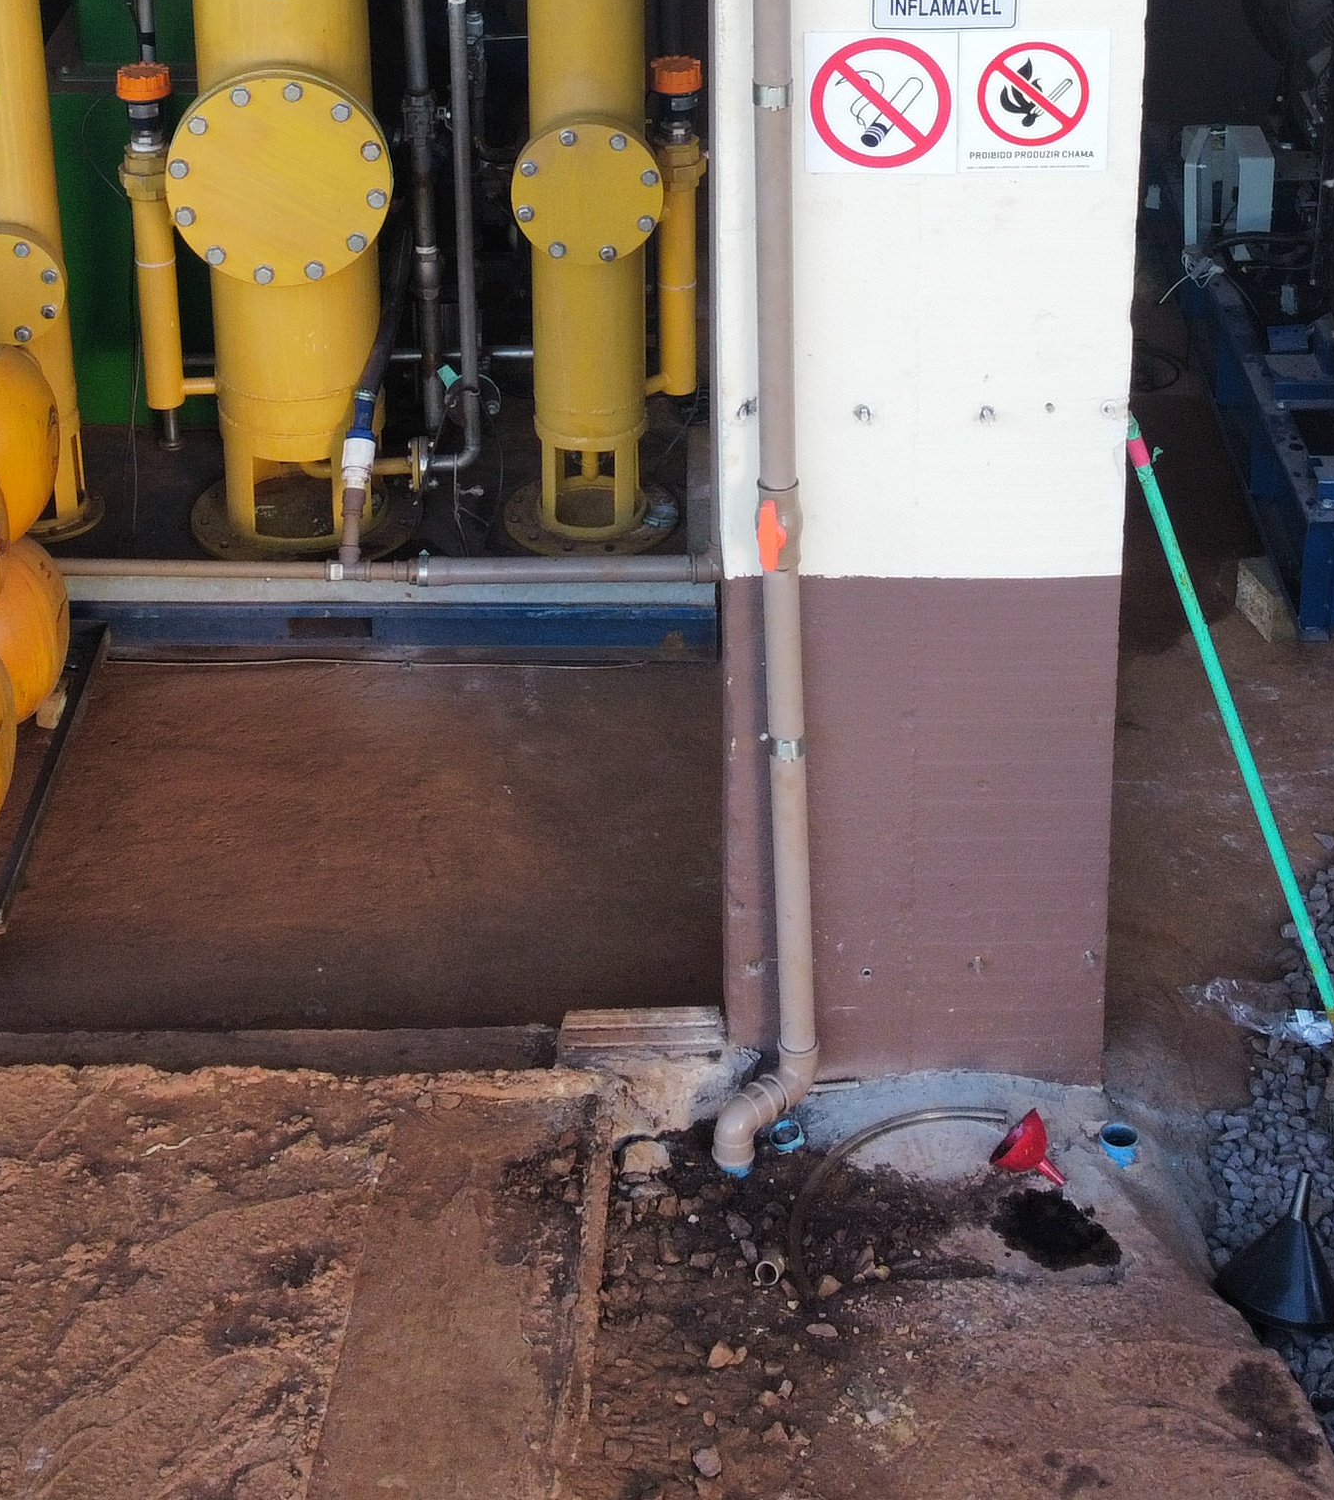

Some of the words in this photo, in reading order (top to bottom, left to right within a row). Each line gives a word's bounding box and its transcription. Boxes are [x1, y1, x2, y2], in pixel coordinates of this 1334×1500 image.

[969, 151, 1013, 160] PROIBIDO
[1014, 150, 1061, 159] PRODUZIR
[1061, 150, 1095, 158] CHAMA
